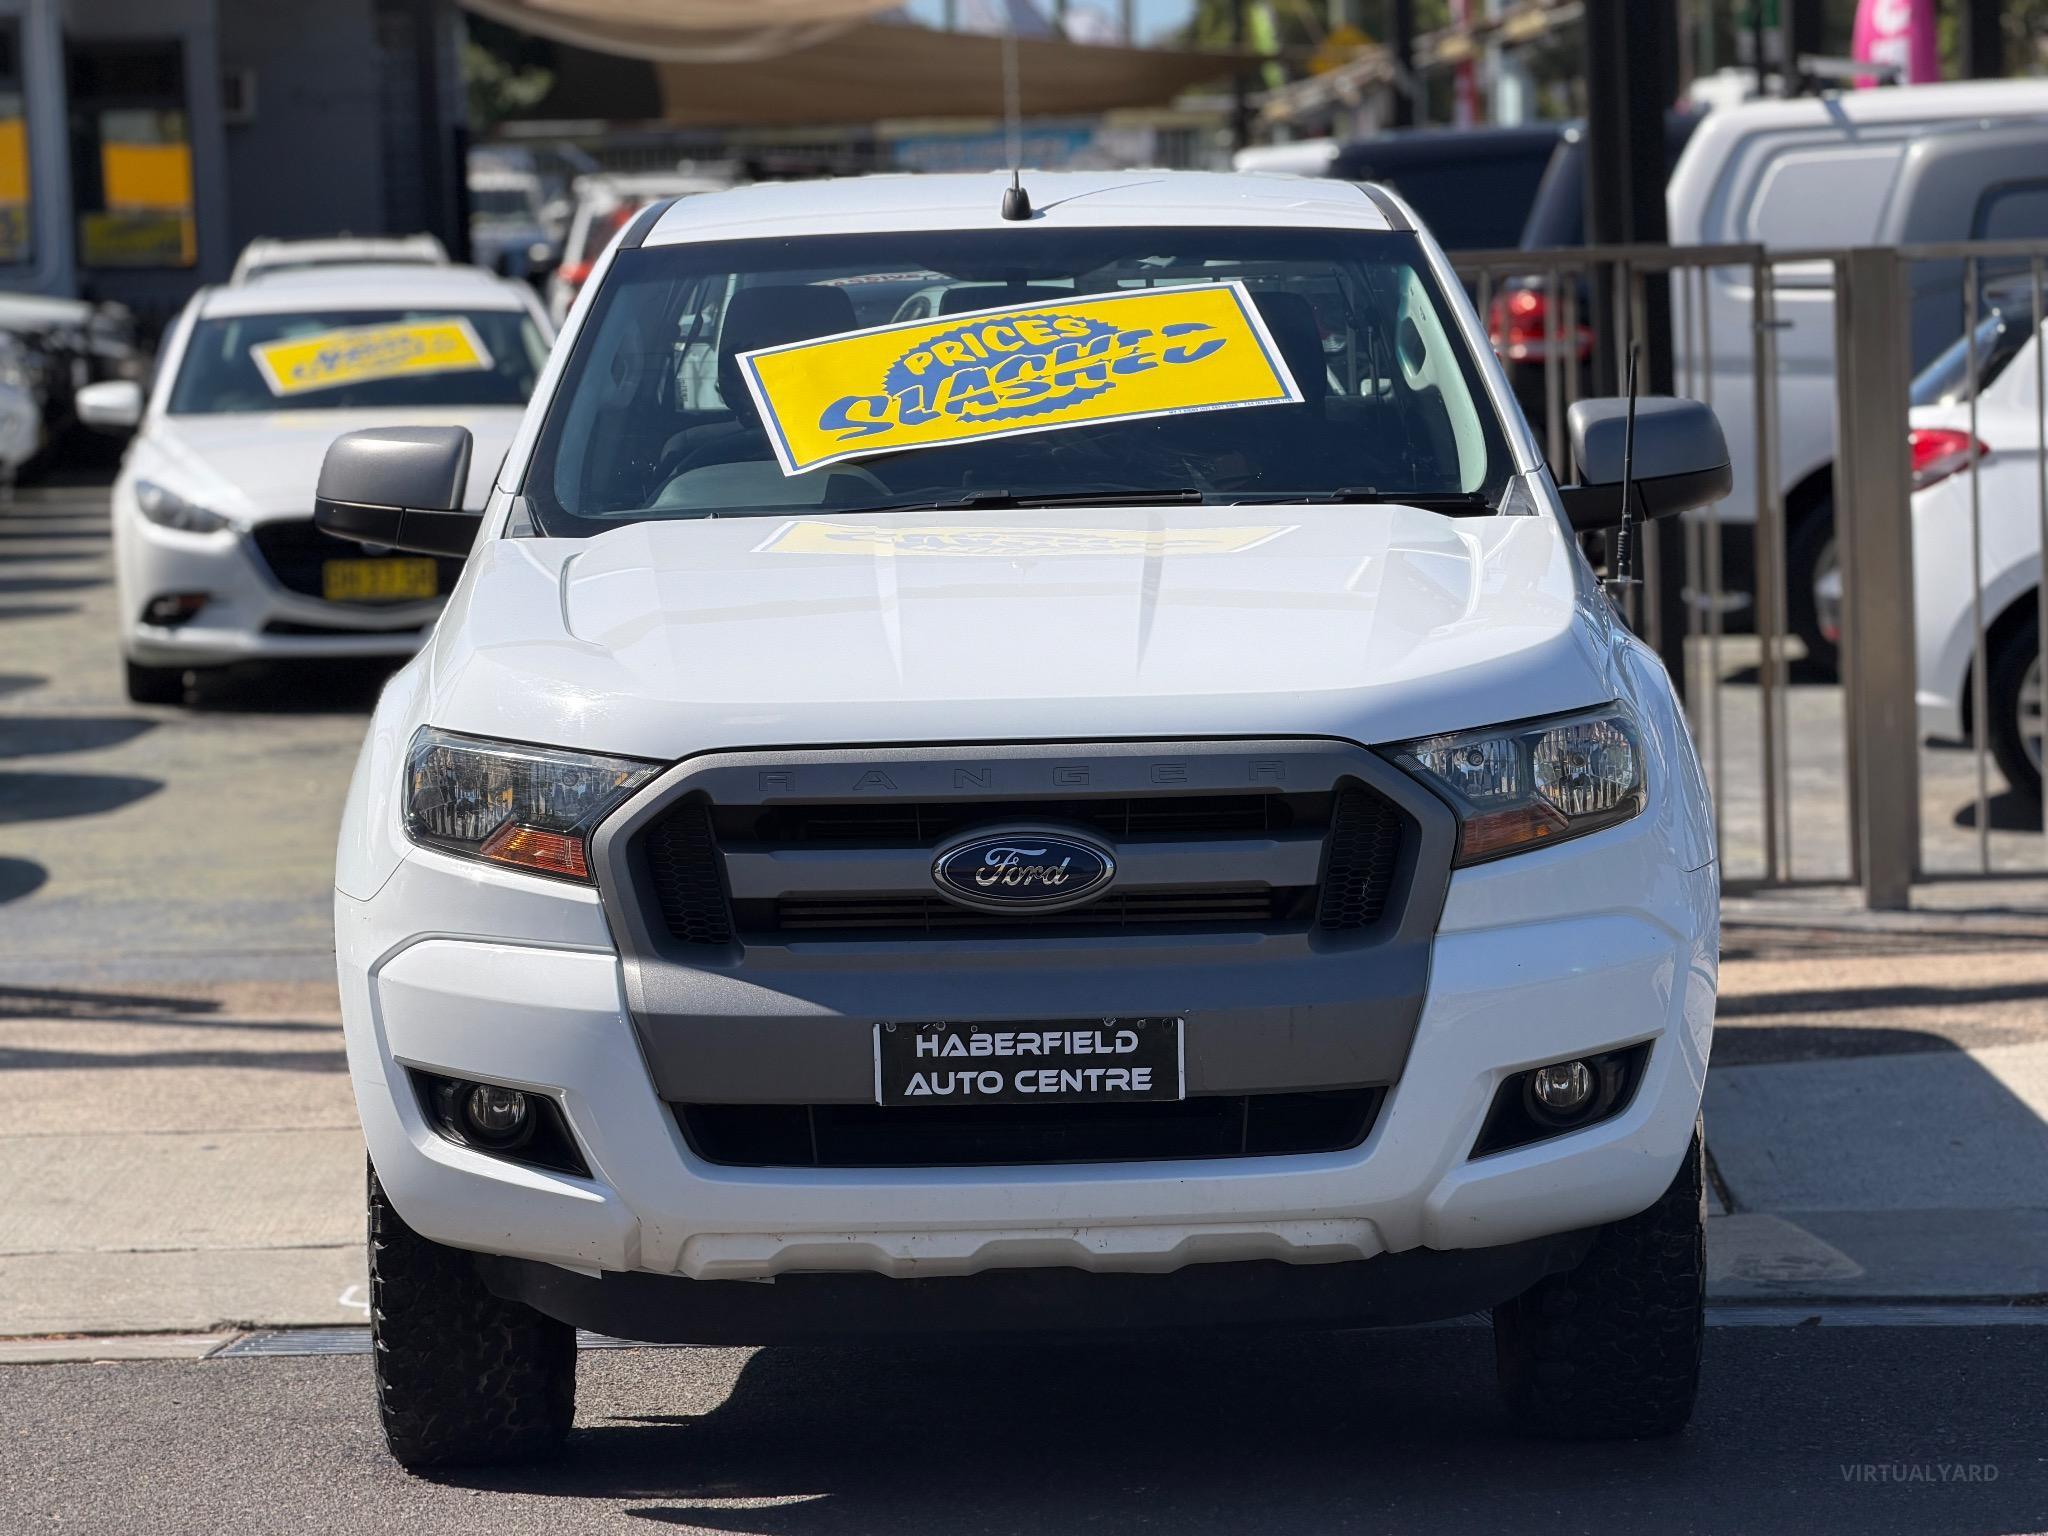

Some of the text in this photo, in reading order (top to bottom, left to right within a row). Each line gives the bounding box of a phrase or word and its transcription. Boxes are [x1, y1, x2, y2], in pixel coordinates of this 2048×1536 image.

[903, 317, 1091, 376] PRICES
[818, 322, 1228, 441] SLASHED
[757, 759, 1286, 792] RANGER
[975, 846, 1071, 887] Ford
[915, 1029, 1139, 1058] HABERFIELD
[903, 1066, 1153, 1096] AUTO CENTRE
